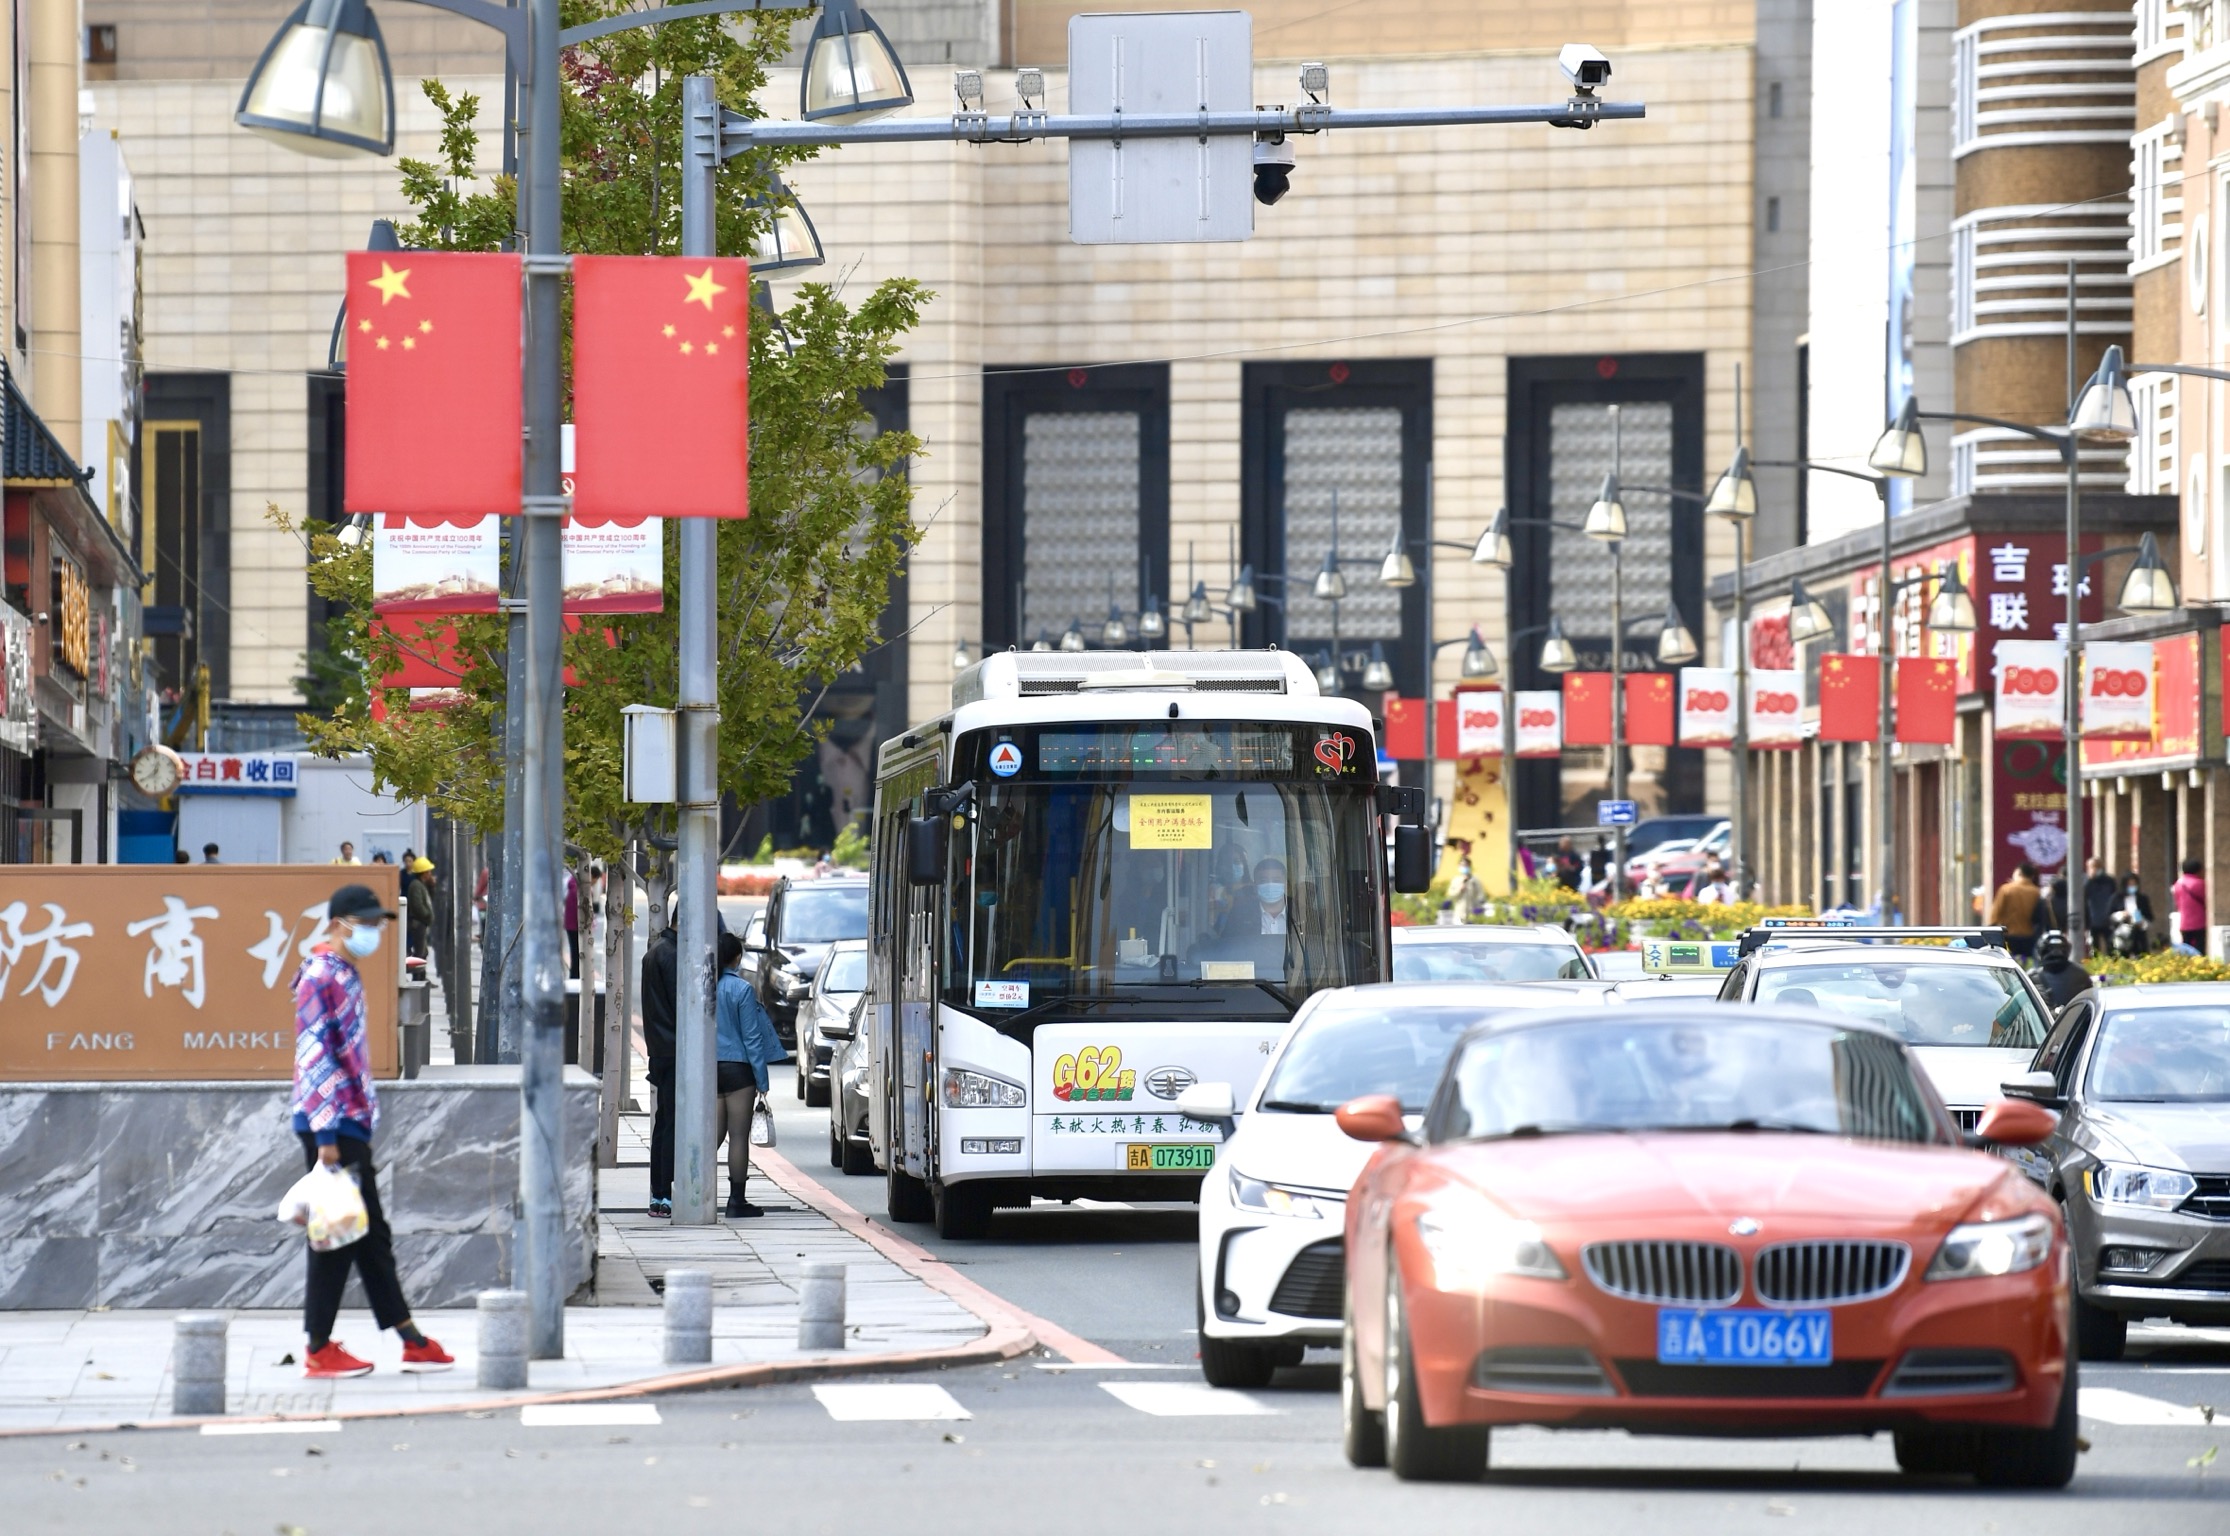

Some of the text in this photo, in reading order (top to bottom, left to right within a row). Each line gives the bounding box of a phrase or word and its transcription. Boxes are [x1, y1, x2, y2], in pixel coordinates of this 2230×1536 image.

[2003, 665, 2059, 695] 100
[2091, 667, 2147, 697] 100
[1649, 944, 1662, 968] TAXI
[47, 1031, 291, 1051] FANG MARKE
[1050, 1116, 1224, 1134] 奉献火热青春 弘扬
